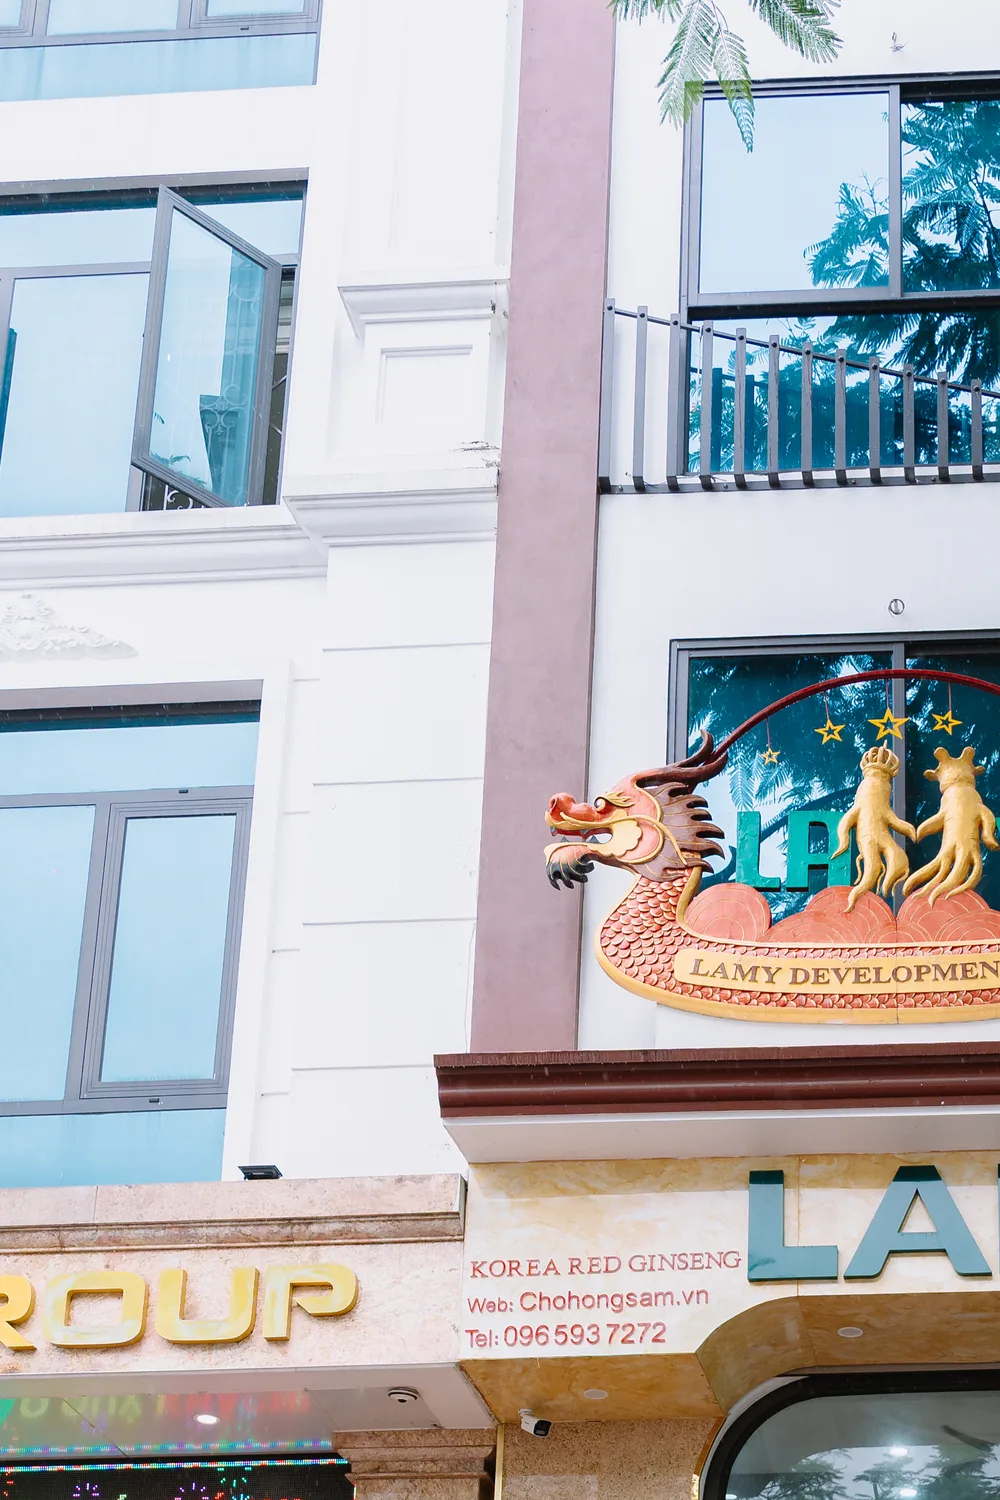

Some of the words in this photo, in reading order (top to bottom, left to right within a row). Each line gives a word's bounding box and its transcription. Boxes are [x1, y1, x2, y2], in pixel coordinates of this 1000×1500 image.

[689, 957, 783, 985] LAMY
[470, 1259, 561, 1278] KOREA
[568, 1255, 622, 1275] RED
[628, 1250, 741, 1272] GINSENG
[467, 1297, 514, 1313] Web:
[519, 1288, 709, 1313] Chohongsam.vn
[465, 1329, 499, 1347] Tel:
[504, 1324, 550, 1346] 096
[554, 1323, 600, 1345] 593
[606, 1321, 667, 1344] 7272
